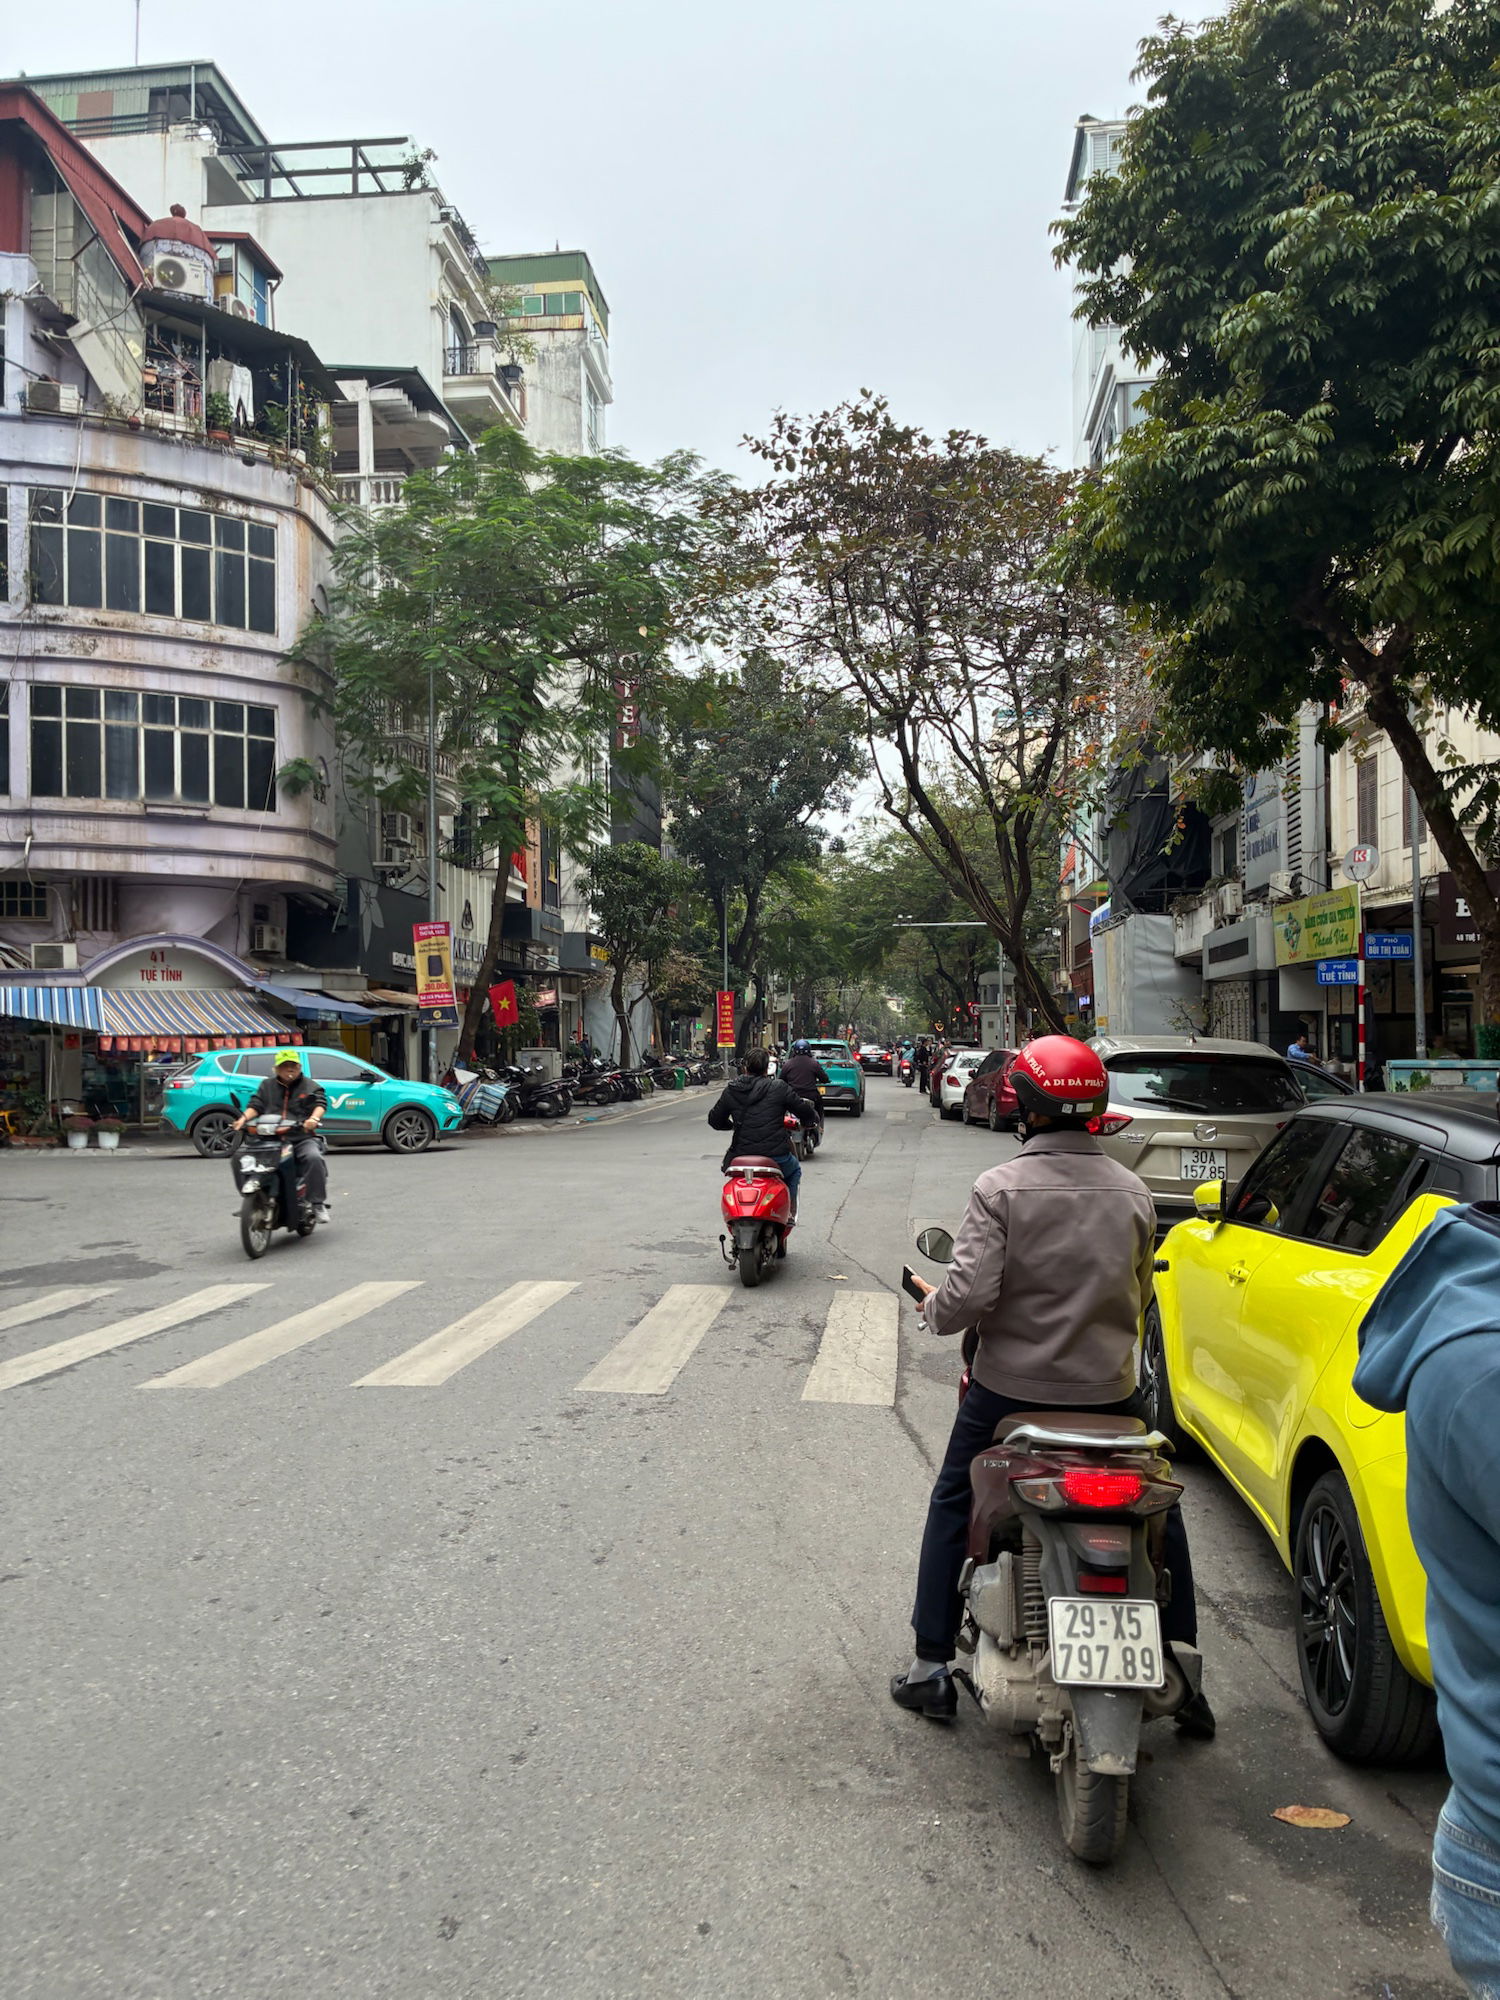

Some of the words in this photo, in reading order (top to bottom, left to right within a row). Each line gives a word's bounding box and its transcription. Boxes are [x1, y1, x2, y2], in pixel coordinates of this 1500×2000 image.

[150, 951, 165, 963] 41
[1380, 946, 1391, 956] THỊ
[1321, 970, 1336, 983] TUỆ
[1337, 969, 1356, 981] TĨNH
[1027, 1056, 1046, 1079] PHẬT
[1043, 1079, 1052, 1087] A
[1053, 1079, 1065, 1087] DI
[1067, 1077, 1082, 1087] ĐÀ
[1085, 1078, 1104, 1088] PHẬT
[1192, 1150, 1216, 1164] 30A
[1184, 1165, 1225, 1179] 157.85
[1065, 1604, 1142, 1641] 29-X5
[1059, 1643, 1155, 1682] 797.89
